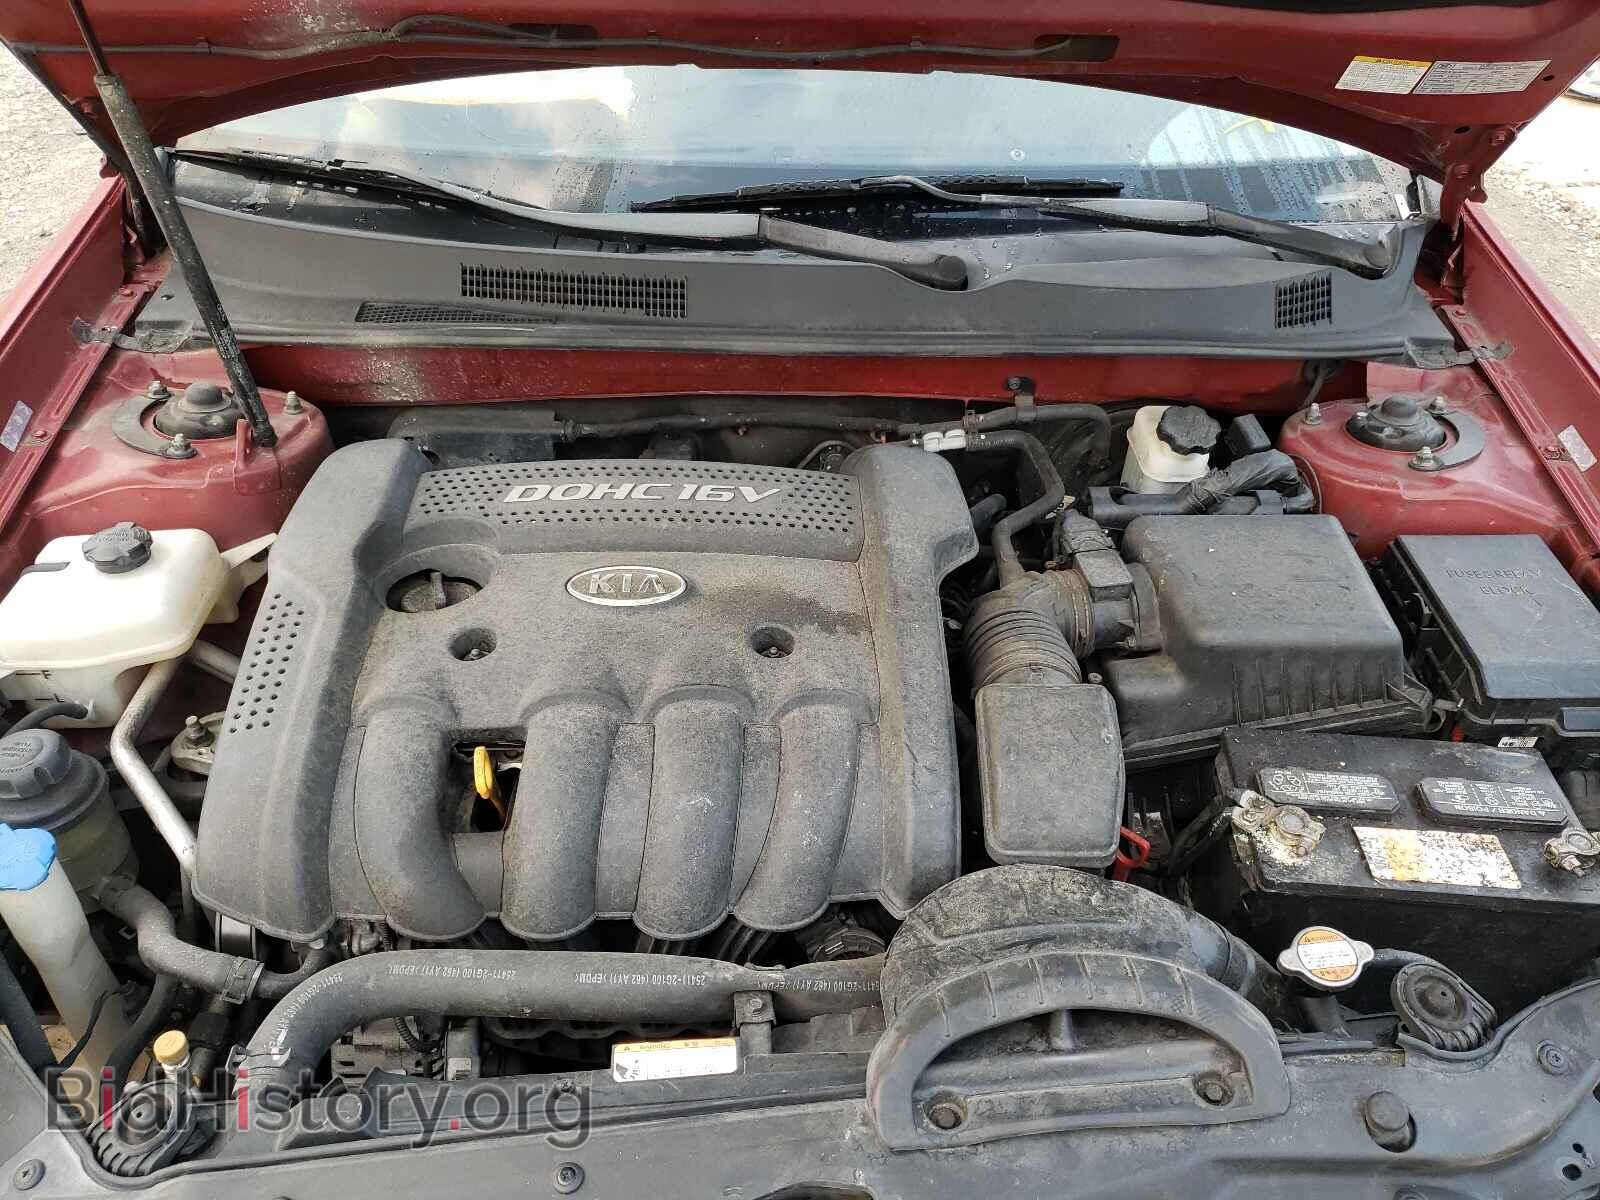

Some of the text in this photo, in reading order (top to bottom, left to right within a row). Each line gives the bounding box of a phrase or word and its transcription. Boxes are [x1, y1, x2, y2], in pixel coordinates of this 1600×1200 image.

[503, 483, 781, 503] DOHC 16V
[589, 573, 666, 594] KIA
[41, 669, 52, 680] F
